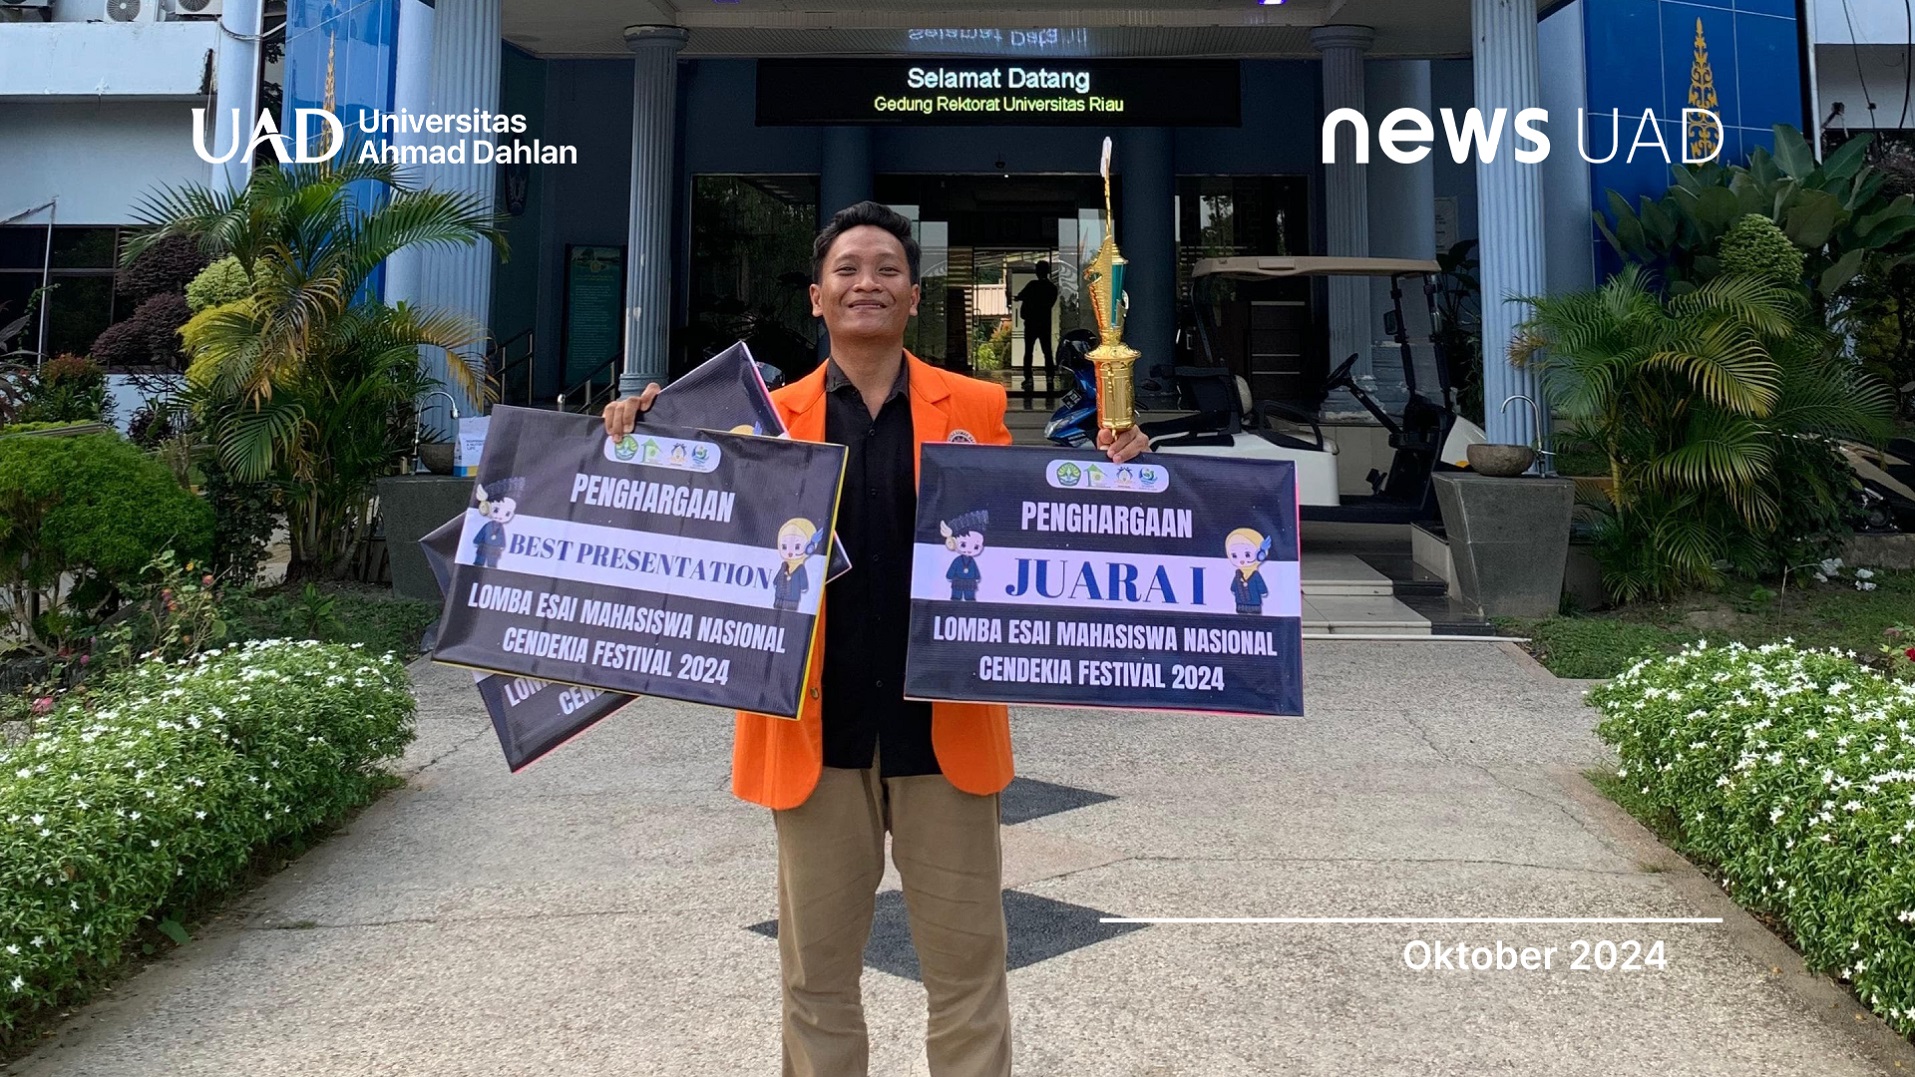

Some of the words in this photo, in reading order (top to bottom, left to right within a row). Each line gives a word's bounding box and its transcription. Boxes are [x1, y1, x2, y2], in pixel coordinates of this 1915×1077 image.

[907, 68, 1000, 89] Selamat
[1008, 68, 1090, 93] Datang
[874, 97, 933, 115] Gedung
[937, 97, 1000, 112] Rektorat
[1003, 97, 1085, 112] Universitas
[1090, 97, 1124, 112] Riau
[570, 473, 735, 523] PENGHARGAAN
[1021, 501, 1193, 538] PENGHARGAAN
[509, 533, 573, 561] BEST
[576, 543, 773, 589] PRESENTATION
[1005, 557, 1179, 605] JUARA
[1190, 566, 1207, 605] I
[467, 582, 531, 615] LOMBA
[536, 593, 576, 622] ESAI
[580, 599, 693, 640] MAHASISWA
[697, 615, 786, 654] NASIONAL
[933, 616, 1001, 643] LOMBA
[1009, 619, 1050, 645] ESAI
[1057, 621, 1178, 651] MAHASISWA
[1184, 627, 1277, 655] NASIONAL
[503, 626, 589, 665] CENDEKIA
[592, 639, 672, 677] FESTIVAL
[677, 654, 730, 686] 2024
[979, 655, 1071, 684] CENDEKIA
[1078, 660, 1165, 688] FESTIVAL
[1171, 664, 1225, 691] 2024
